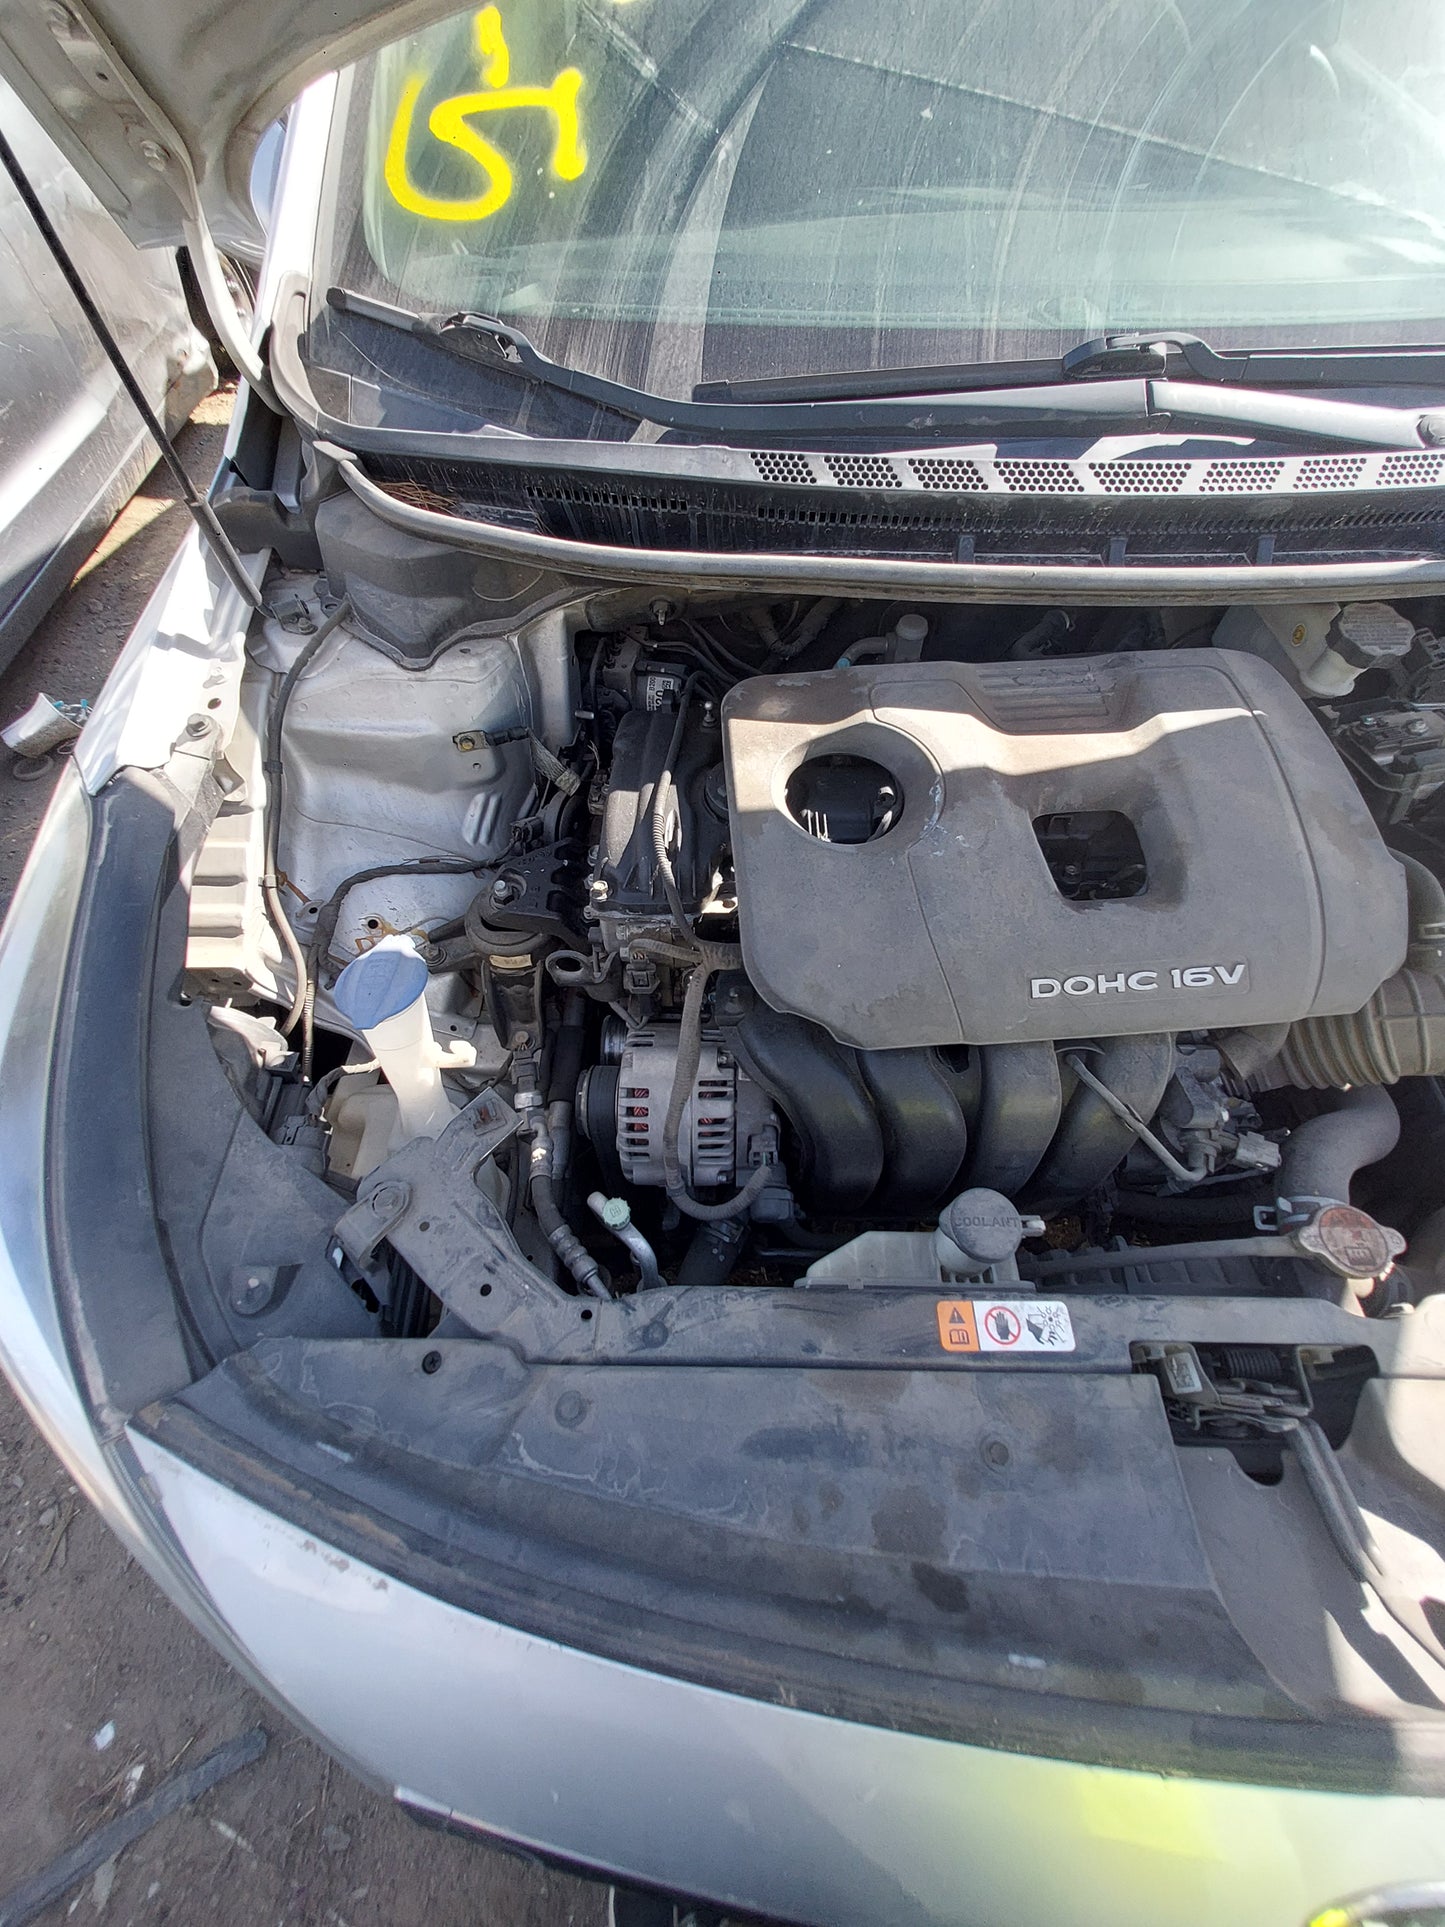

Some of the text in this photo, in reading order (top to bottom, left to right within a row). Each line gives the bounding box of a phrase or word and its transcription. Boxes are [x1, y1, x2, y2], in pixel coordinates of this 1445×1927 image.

[1031, 964, 1246, 999] DOHC 16V
[953, 1216, 1018, 1228] COOLANT
